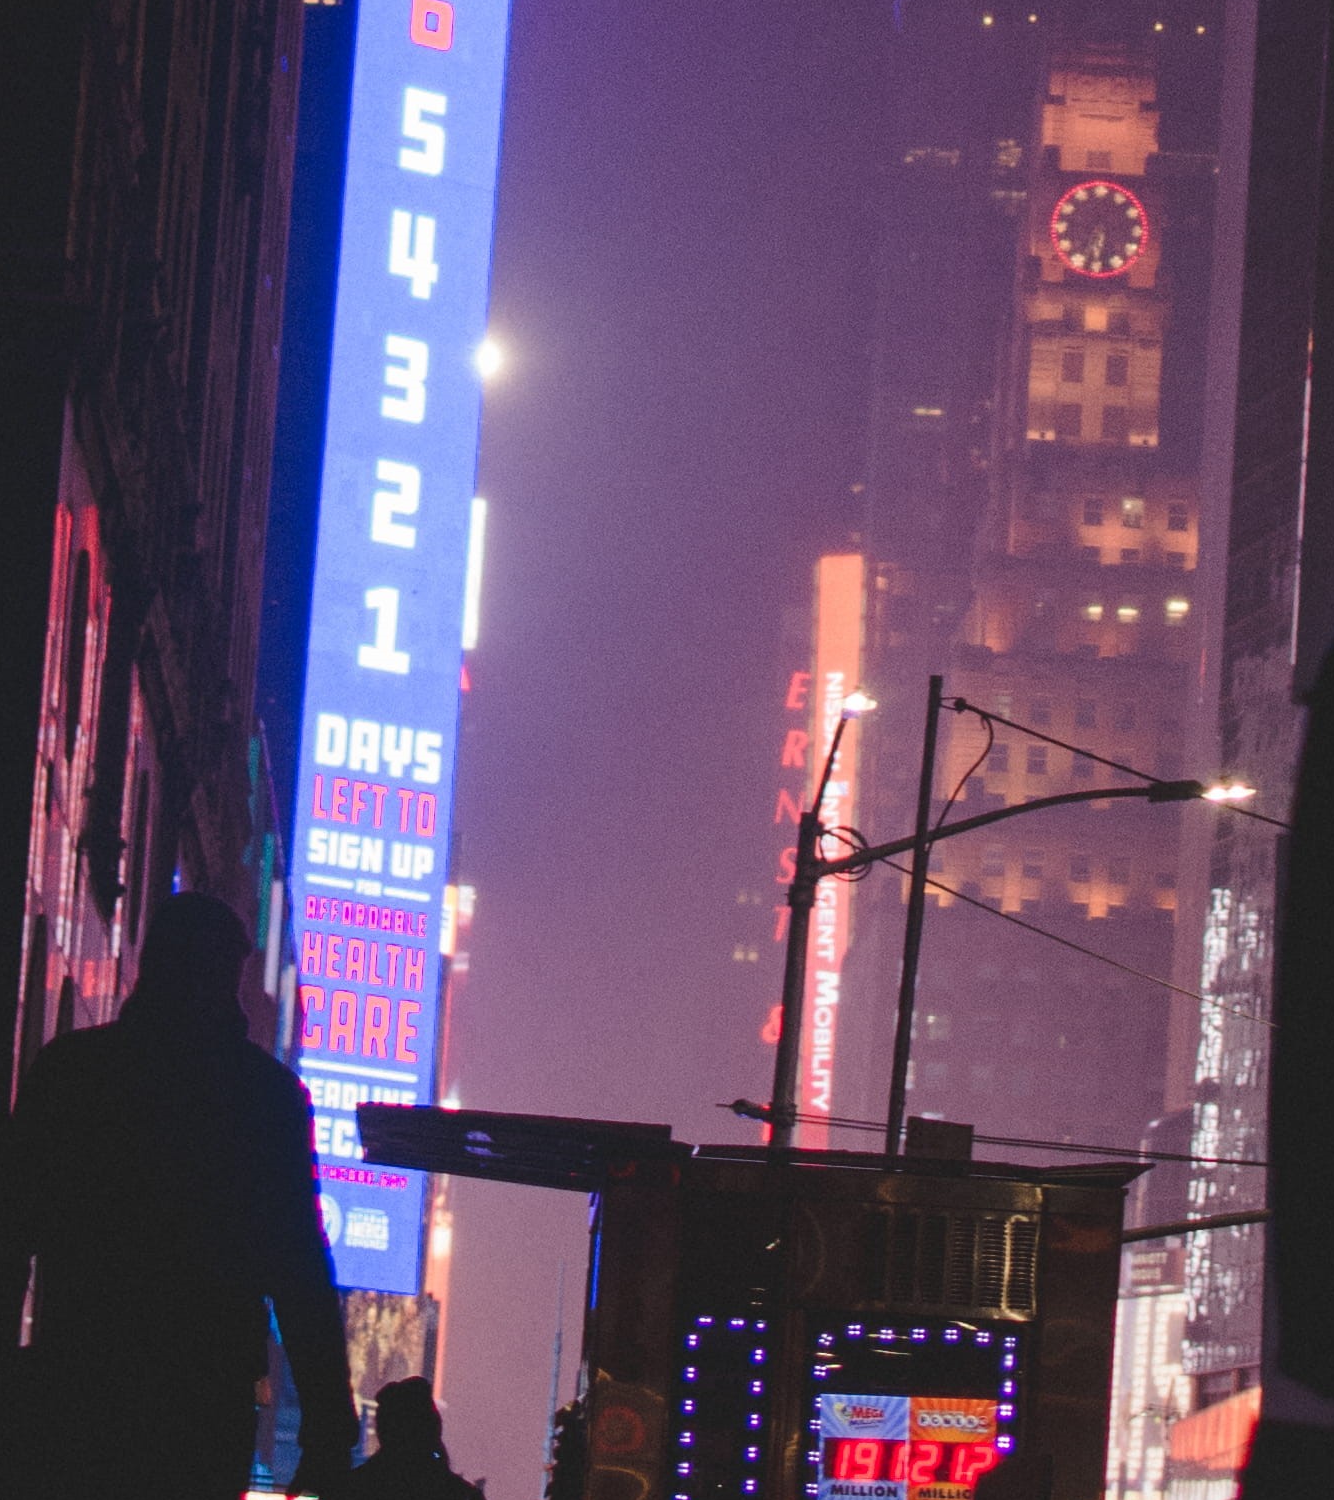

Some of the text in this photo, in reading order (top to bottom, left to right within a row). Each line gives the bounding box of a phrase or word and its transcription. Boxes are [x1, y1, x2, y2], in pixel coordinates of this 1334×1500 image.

[398, 86, 447, 177] 5
[388, 209, 439, 300] 4
[380, 333, 430, 425] 3
[370, 458, 422, 549] 2
[357, 586, 411, 675] 1
[313, 712, 444, 784] DAYS
[312, 774, 438, 838] LEFT TO
[307, 827, 436, 881] SIGN UP
[305, 895, 429, 939] AFFORDABLE
[300, 931, 427, 992] HEALTH
[299, 984, 422, 1063] CARE
[809, 970, 840, 1112] MOBILITY
[830, 1484, 898, 1498] MILLION
[918, 1486, 972, 1500] MILLIO
